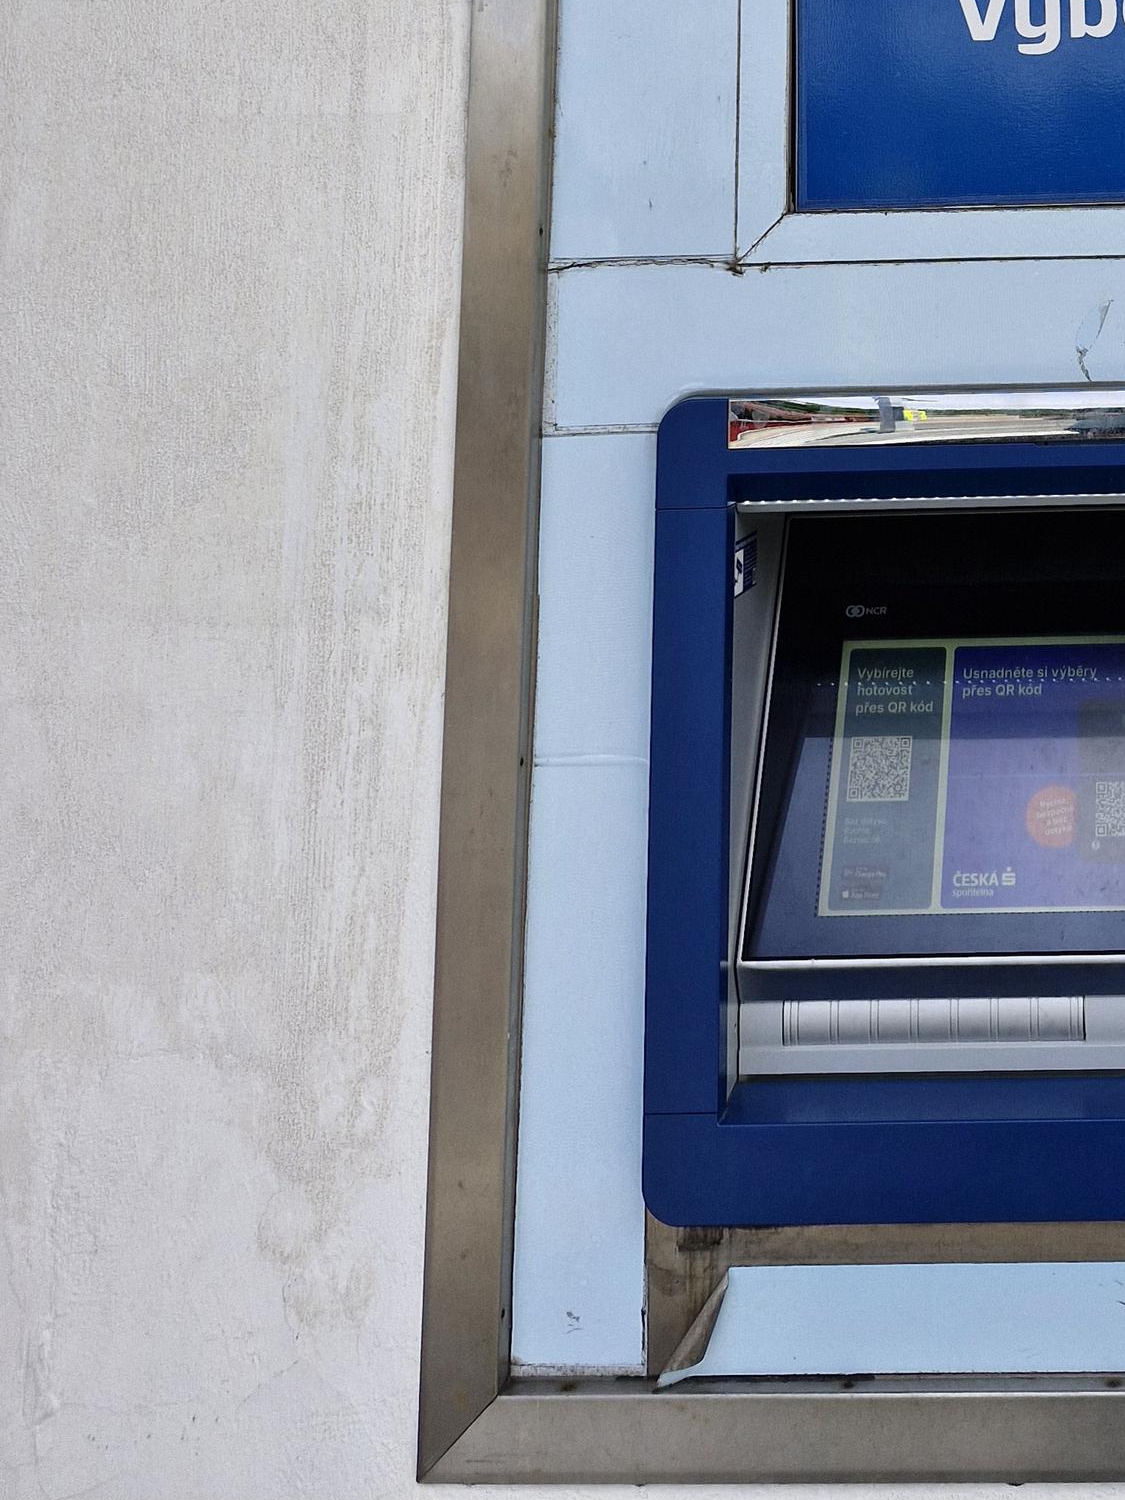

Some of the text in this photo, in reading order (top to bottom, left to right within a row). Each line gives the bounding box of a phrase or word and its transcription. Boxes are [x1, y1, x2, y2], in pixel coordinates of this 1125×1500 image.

[865, 606, 887, 615] NCR
[857, 667, 914, 680] Vybírejte
[963, 665, 1097, 680] Usnadněte si výběry
[857, 683, 913, 696] hotovost
[962, 684, 1042, 698] přes QR kód
[855, 701, 933, 715] přes QR kód
[953, 870, 999, 887] ČESKÁ
